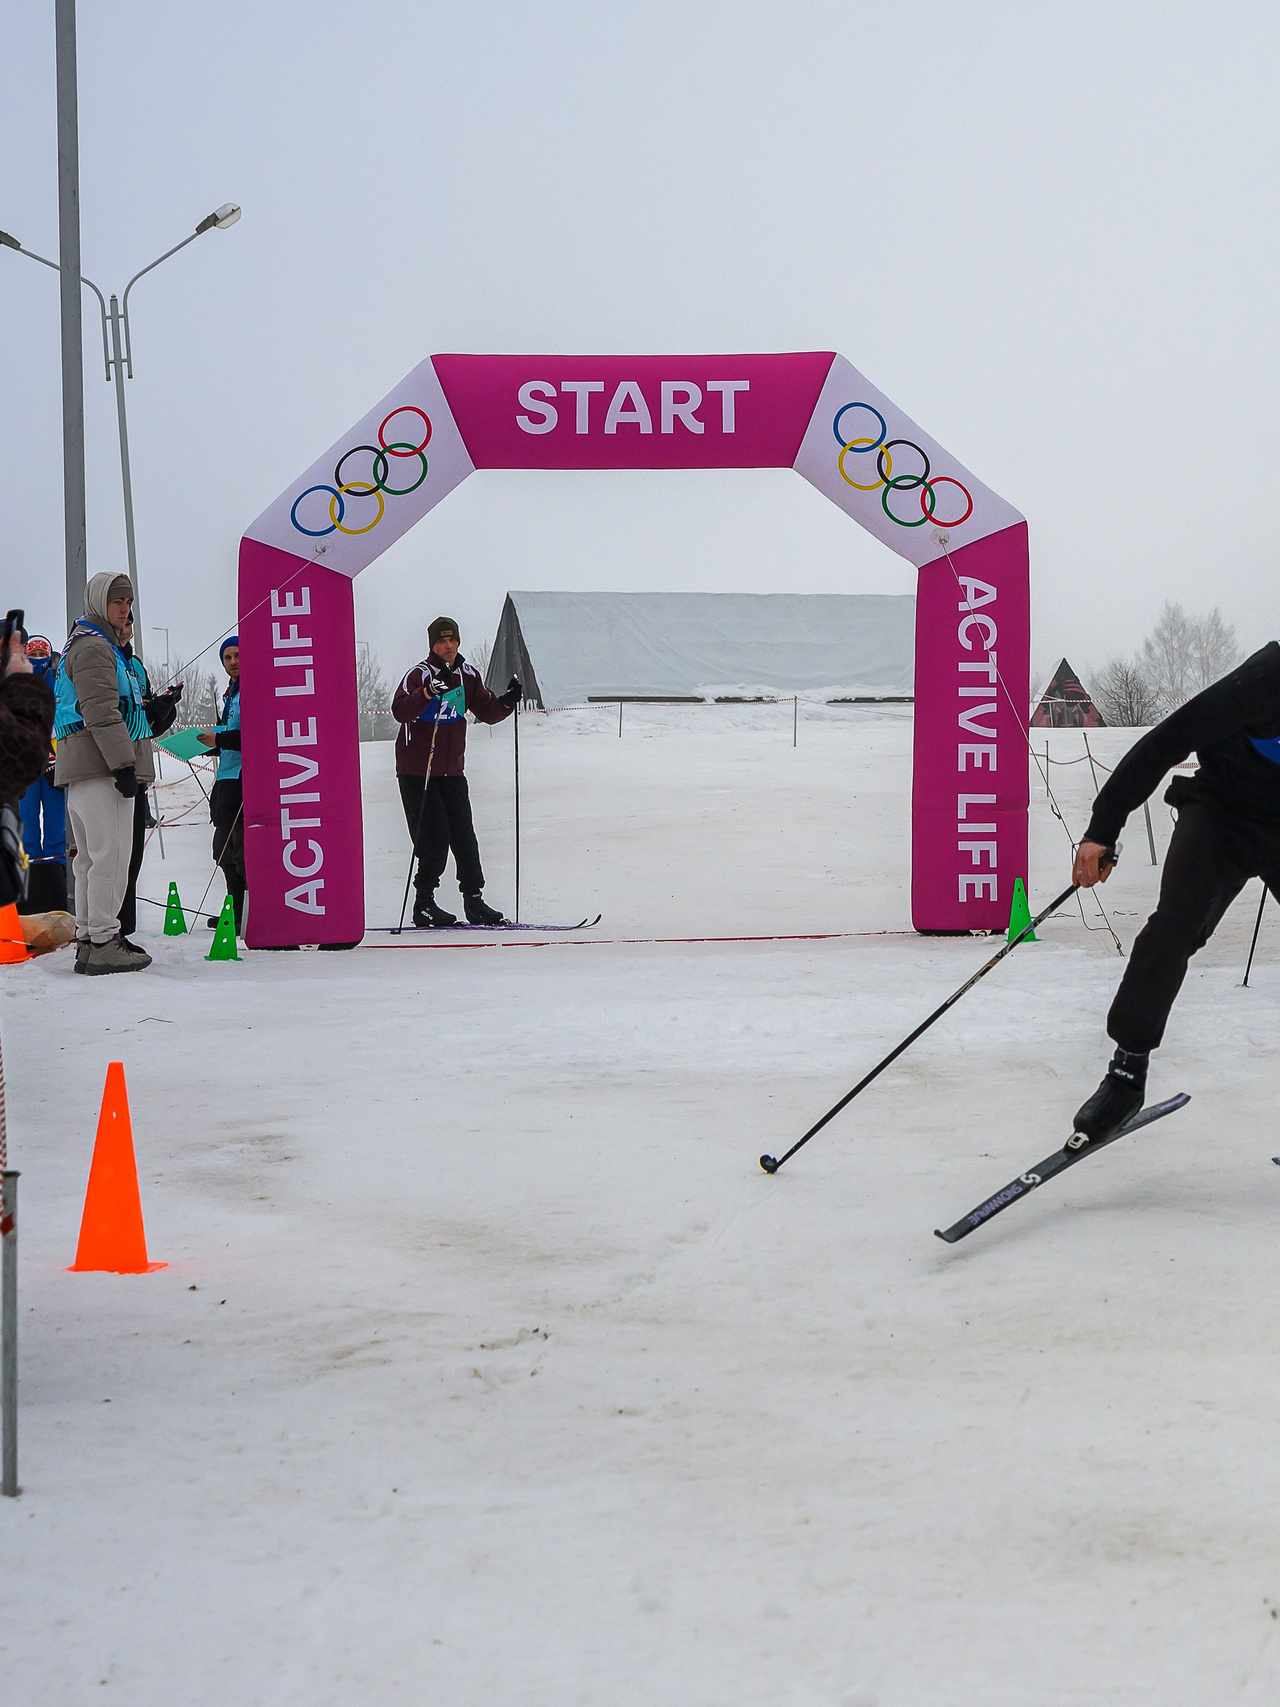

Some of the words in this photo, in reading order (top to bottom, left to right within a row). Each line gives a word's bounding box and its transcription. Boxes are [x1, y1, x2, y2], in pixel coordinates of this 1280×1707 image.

[516, 380, 750, 435] START
[270, 586, 315, 697] LIFE
[957, 576, 998, 772] ACTIVE
[276, 716, 326, 915] ACTIVE
[957, 793, 998, 903] LIFE
